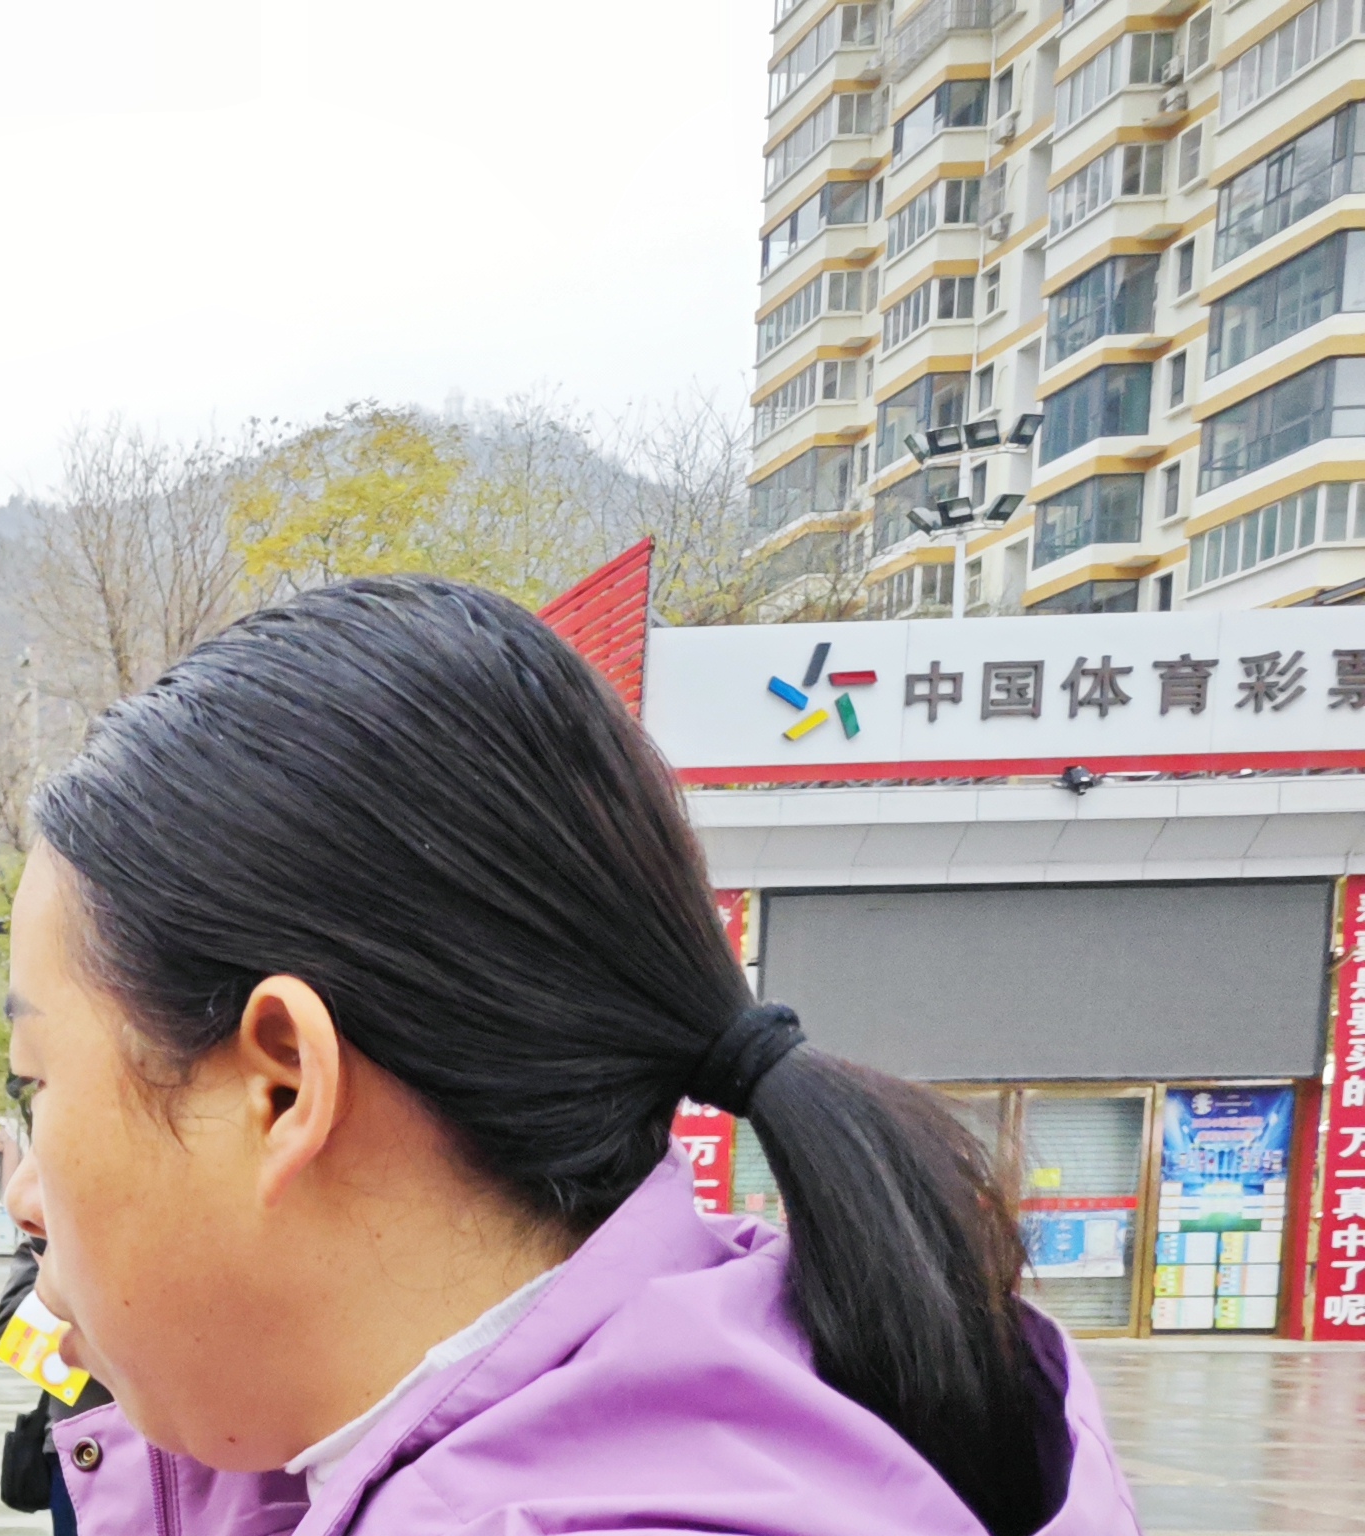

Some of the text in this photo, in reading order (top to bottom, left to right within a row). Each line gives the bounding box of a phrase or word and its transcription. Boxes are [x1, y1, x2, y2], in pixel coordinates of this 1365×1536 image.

[904, 649, 1365, 724] 中国体育彩票
